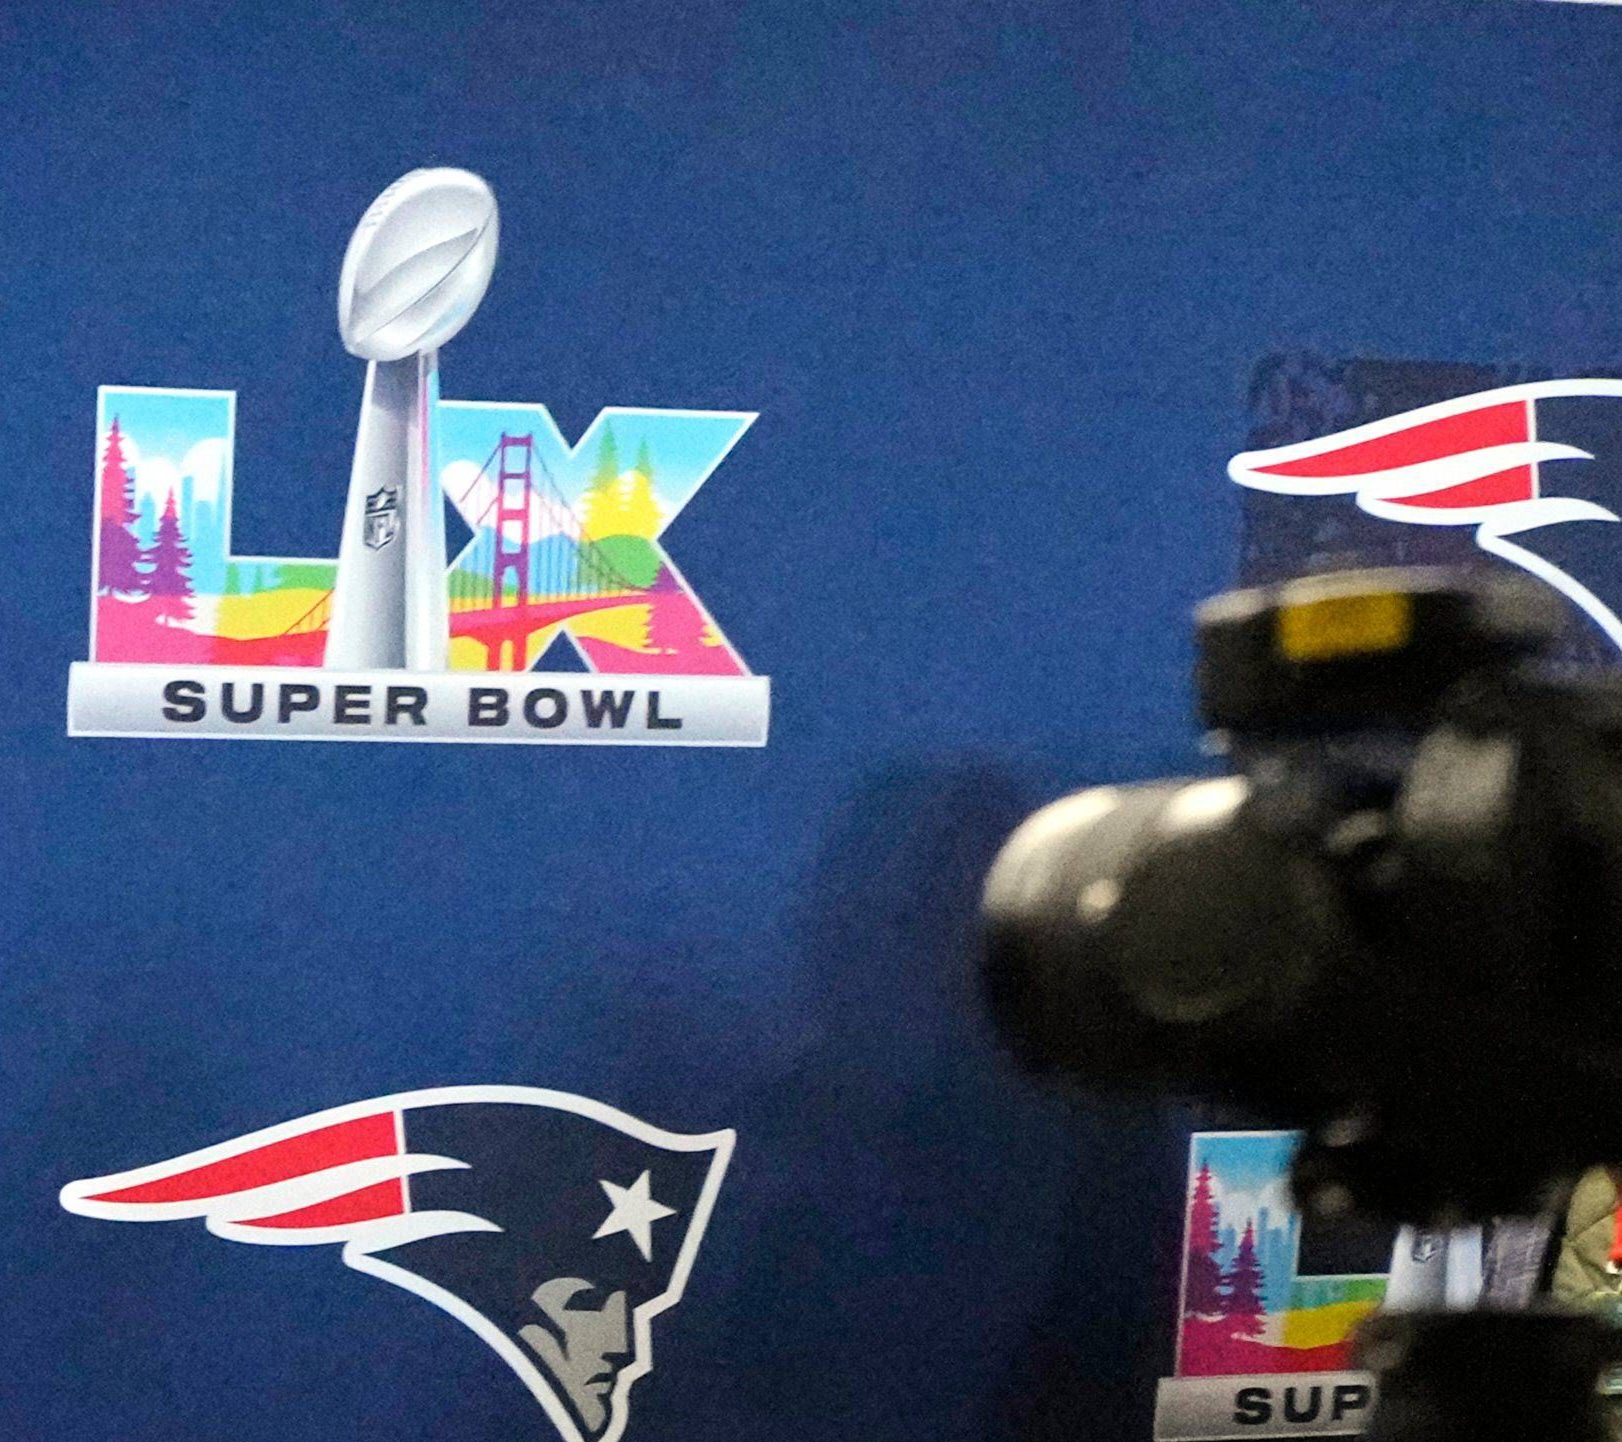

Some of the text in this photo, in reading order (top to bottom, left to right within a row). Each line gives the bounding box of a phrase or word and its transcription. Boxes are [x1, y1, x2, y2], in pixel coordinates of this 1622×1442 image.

[162, 679, 683, 730] SUPER BOWL
[1233, 1384, 1370, 1426] SUP
